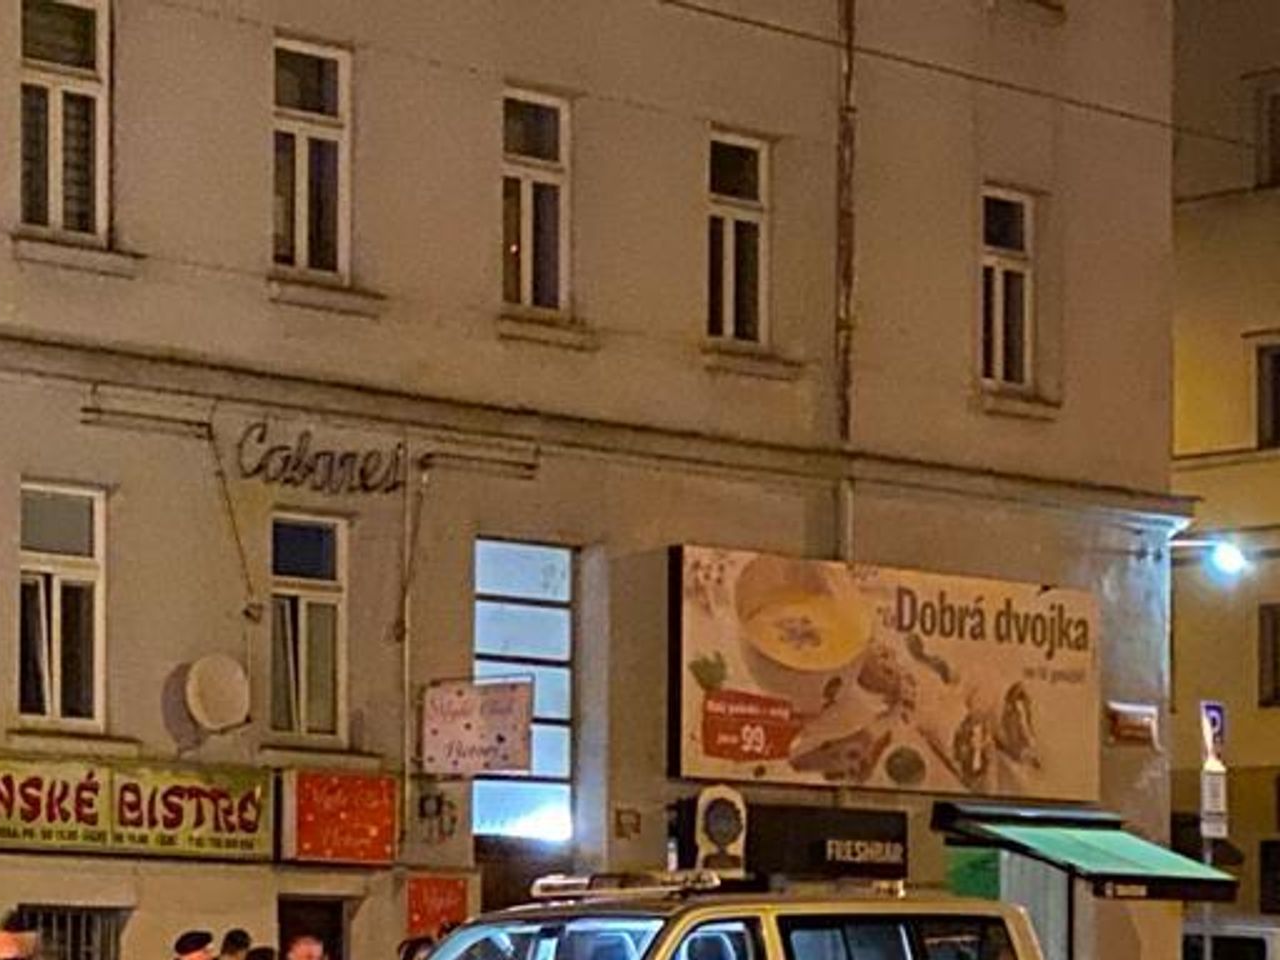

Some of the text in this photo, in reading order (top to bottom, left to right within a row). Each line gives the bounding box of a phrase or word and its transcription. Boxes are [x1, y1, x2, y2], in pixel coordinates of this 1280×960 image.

[896, 586, 1089, 660] Dobrá dvojka
[117, 781, 262, 834] BISTRO
